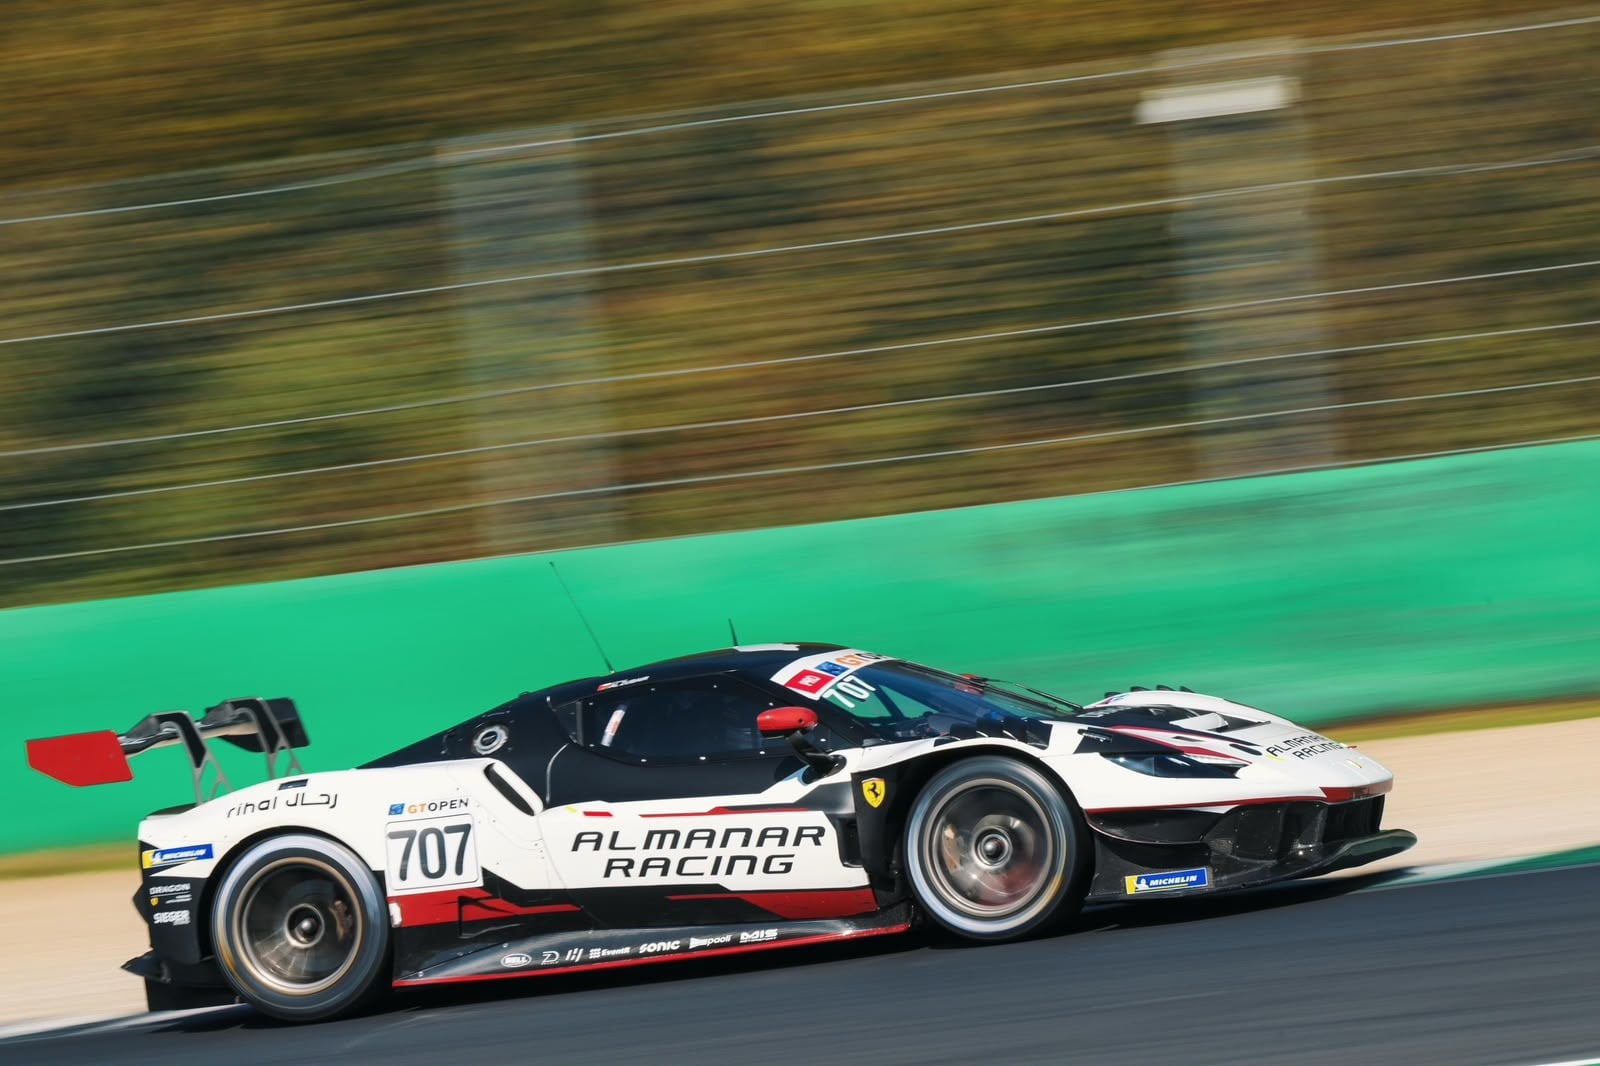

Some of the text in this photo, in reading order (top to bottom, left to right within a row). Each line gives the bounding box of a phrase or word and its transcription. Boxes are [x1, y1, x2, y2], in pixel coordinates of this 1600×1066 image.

[822, 675, 876, 708] 707
[227, 796, 277, 818] rihal
[571, 826, 826, 852] ALMANAR
[387, 823, 471, 881] 707
[603, 854, 796, 878] RACING
[1149, 875, 1198, 886] MICHELIN
